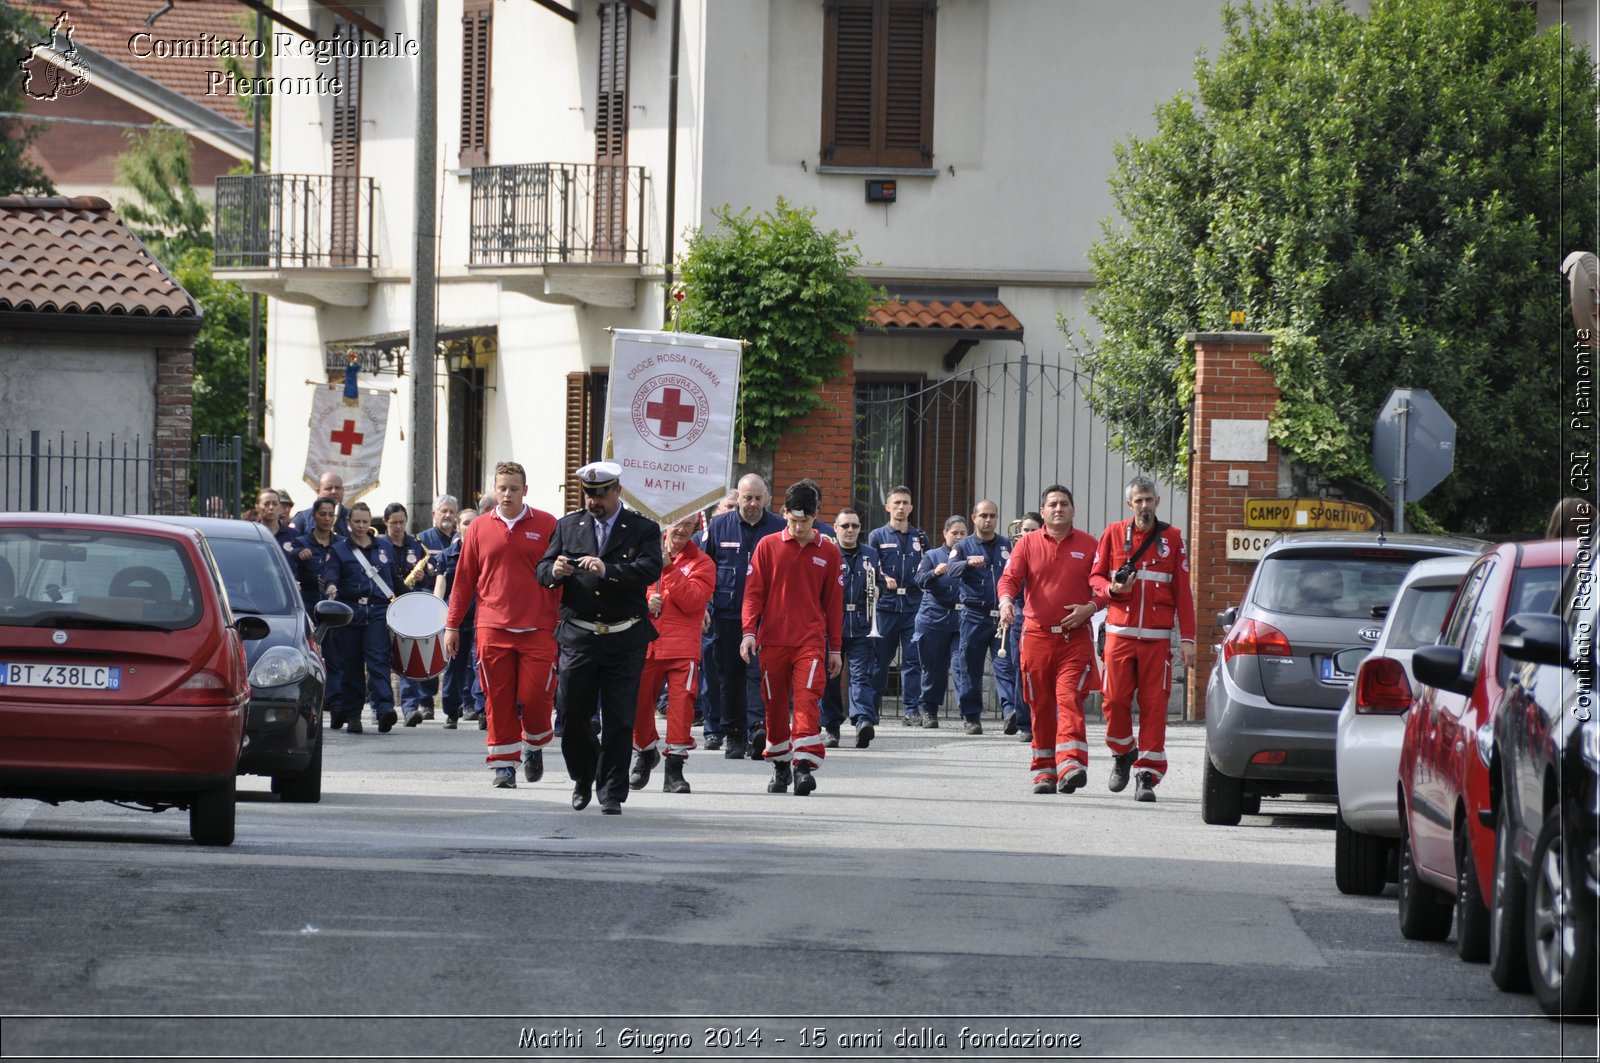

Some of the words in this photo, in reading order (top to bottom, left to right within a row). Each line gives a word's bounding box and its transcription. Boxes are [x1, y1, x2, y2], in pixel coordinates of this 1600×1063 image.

[627, 357, 655, 381] CROCE
[656, 353, 687, 364] ROSSA
[689, 358, 721, 388] ITALIANA
[633, 385, 651, 438] CONVENZIONE
[649, 379, 658, 388] DI
[658, 376, 691, 389] GINEVRA
[690, 385, 701, 395] 22
[696, 395, 708, 428] AGOSTO
[623, 458, 694, 474] DELEGAZIONE
[698, 465, 708, 474] DI
[644, 478, 685, 491] MATHI
[1250, 506, 1290, 521] CAMPO
[1310, 507, 1366, 525] SPORTIVO
[10, 665, 35, 683] BT
[42, 666, 105, 686] 438LC
[109, 678, 119, 687] TO
